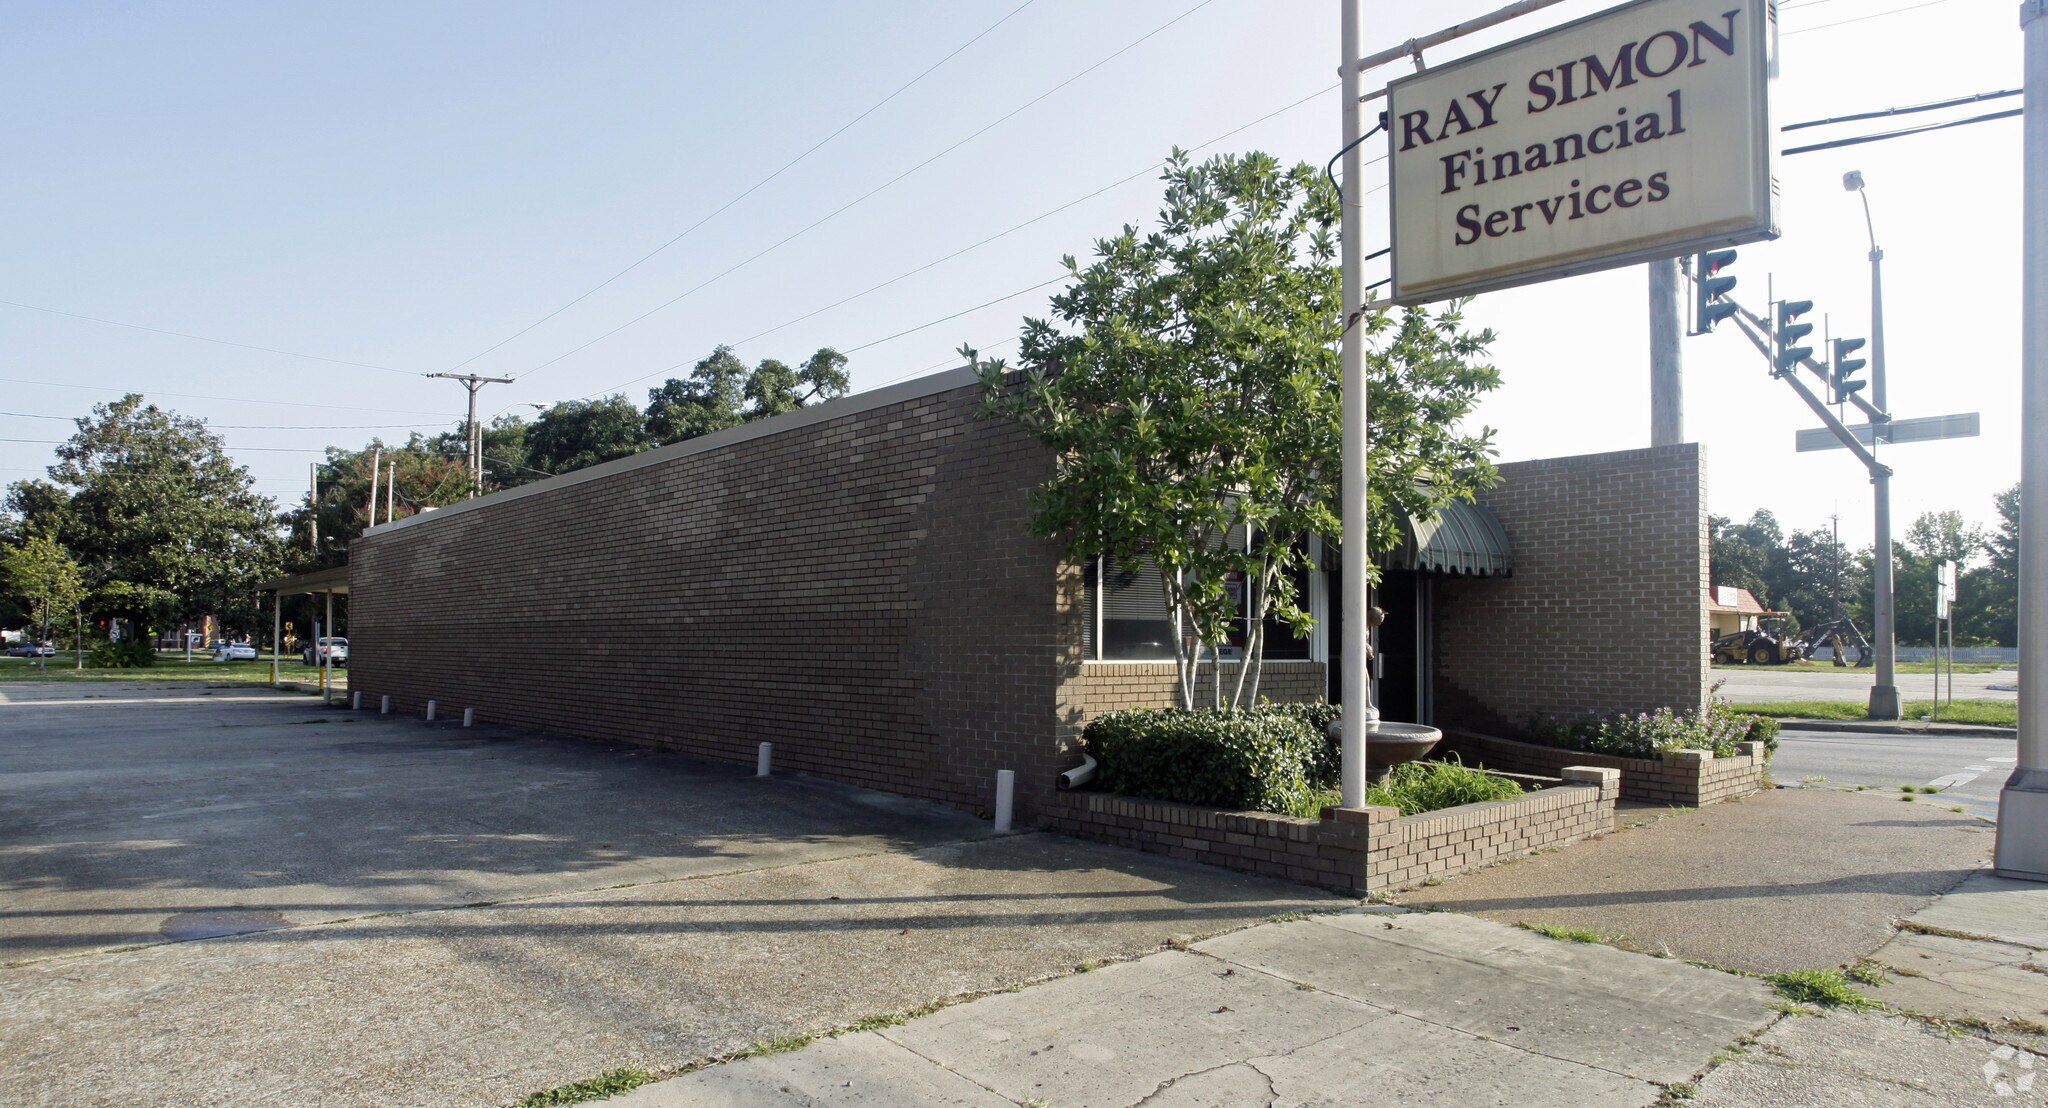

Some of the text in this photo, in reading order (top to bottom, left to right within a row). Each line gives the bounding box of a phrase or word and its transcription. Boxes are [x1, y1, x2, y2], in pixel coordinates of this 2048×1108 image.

[1399, 9, 1741, 152] RAY SIMON
[1439, 89, 1686, 195] Financial
[1454, 171, 1670, 247] Services
